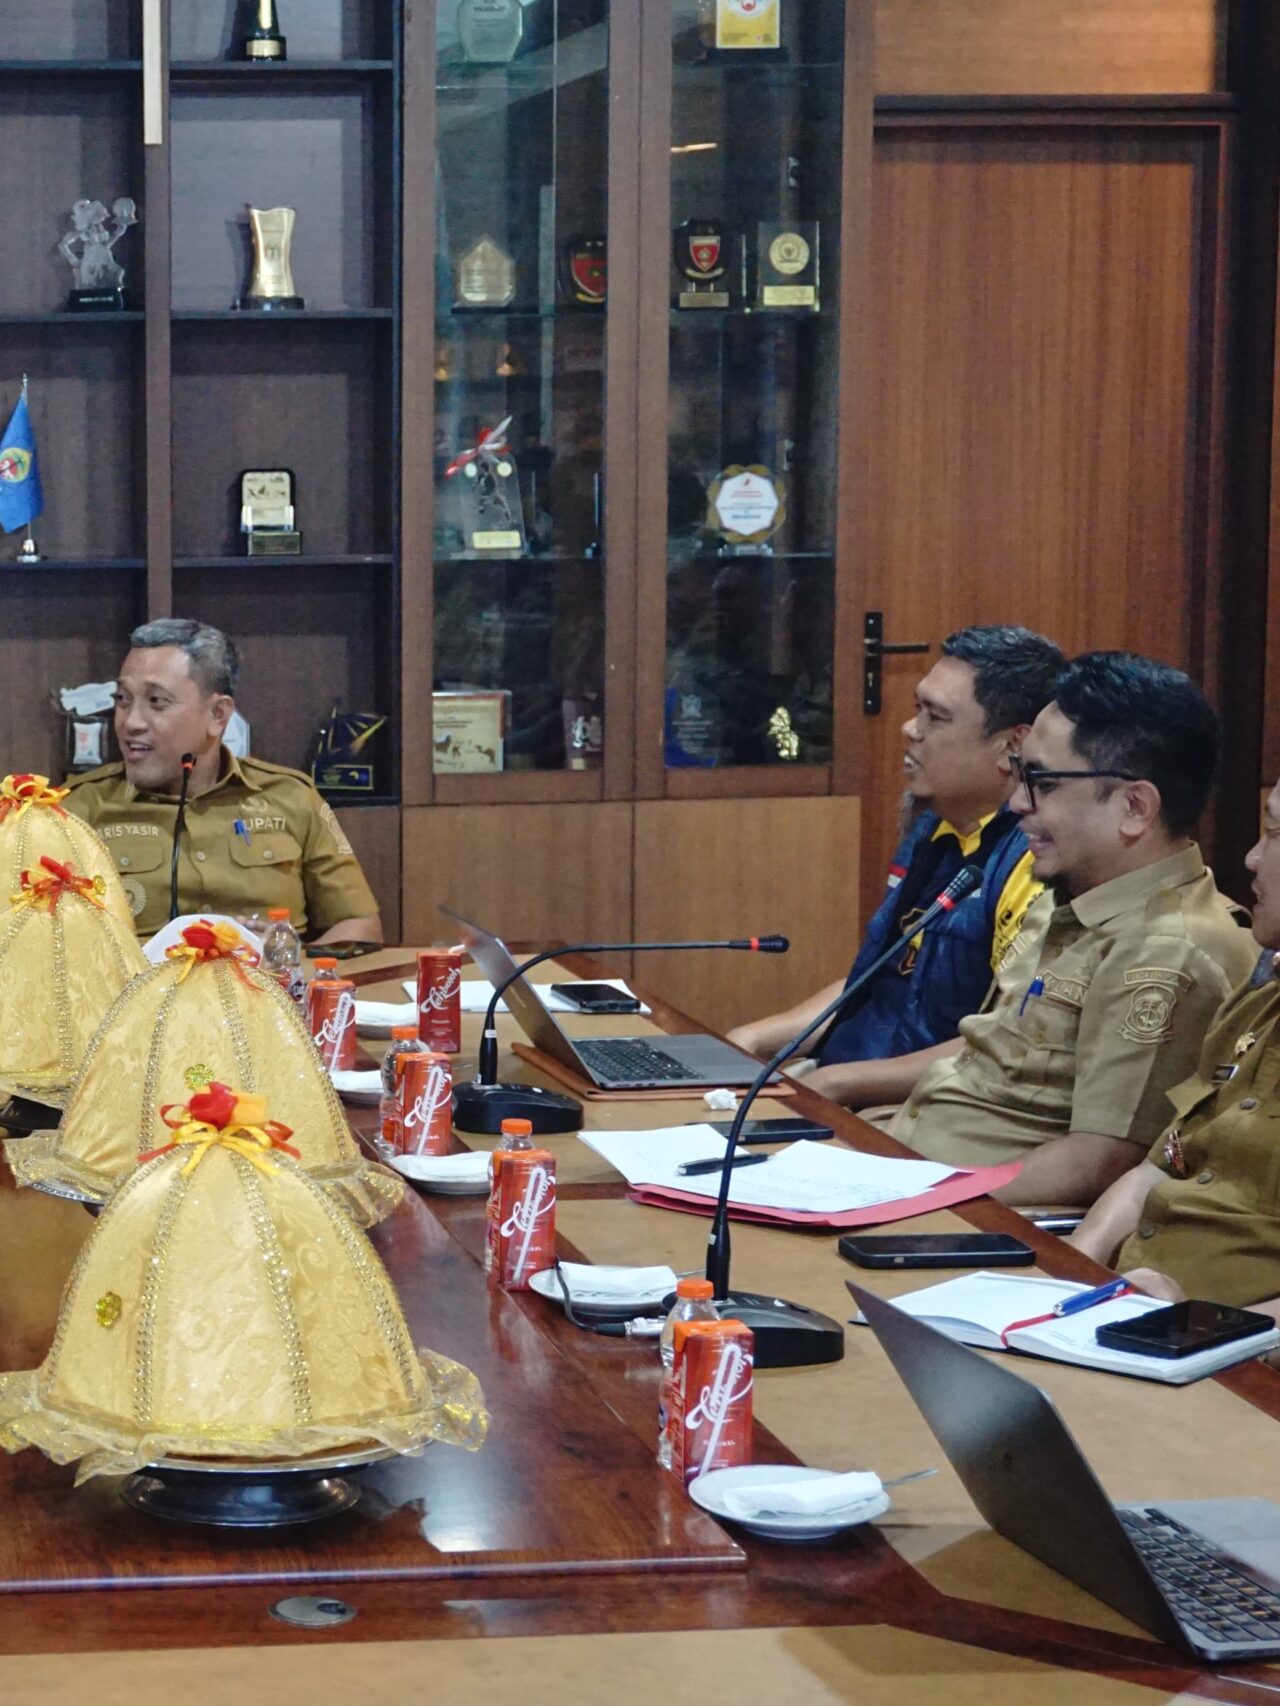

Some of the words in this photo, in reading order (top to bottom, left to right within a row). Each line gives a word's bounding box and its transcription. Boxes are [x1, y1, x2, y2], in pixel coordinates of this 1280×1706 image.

[246, 816, 286, 831] UPATI
[96, 825, 123, 839] ARIS
[124, 824, 159, 837] YASIR
